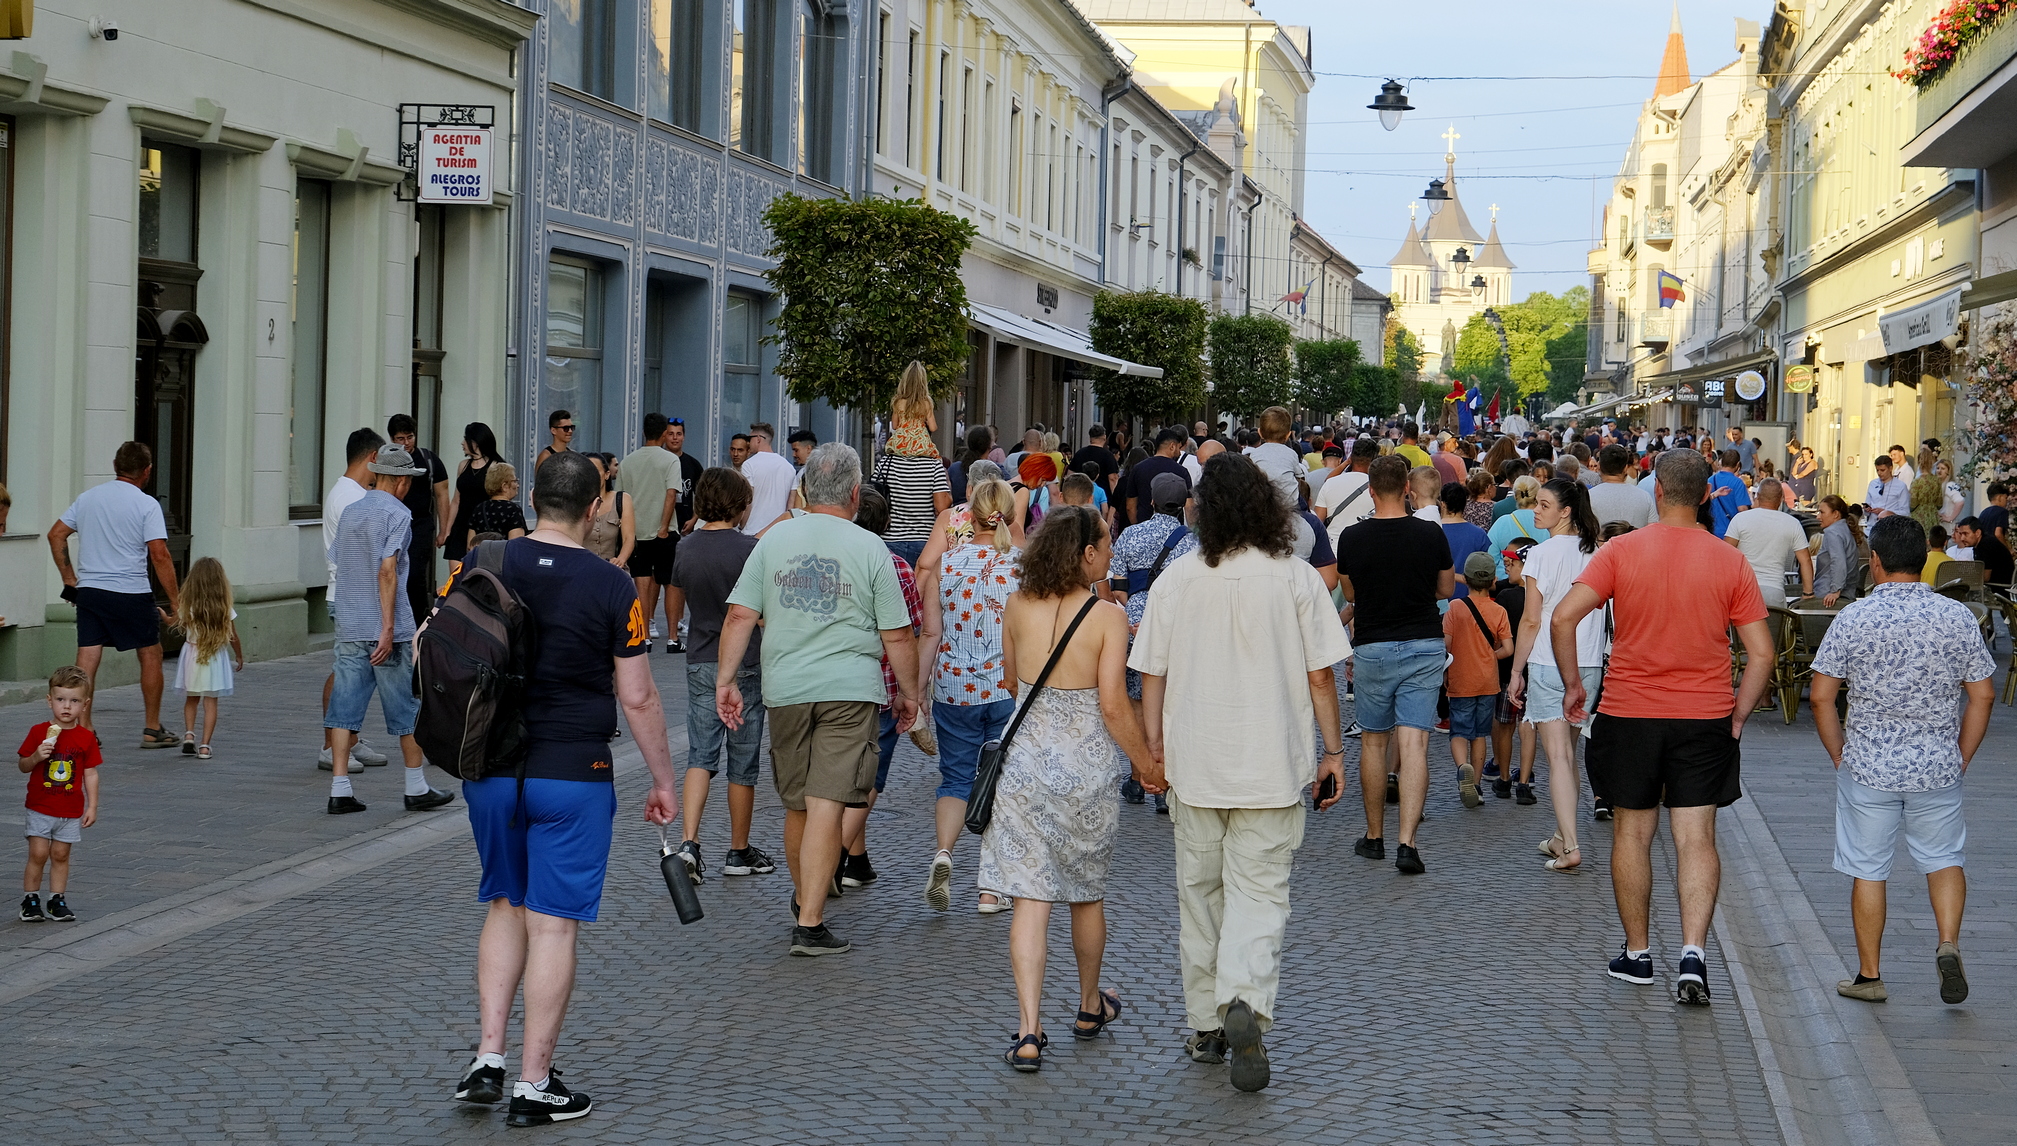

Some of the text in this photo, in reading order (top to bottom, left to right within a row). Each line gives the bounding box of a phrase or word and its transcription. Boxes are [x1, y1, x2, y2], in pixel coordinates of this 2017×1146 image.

[433, 134, 481, 145] AGENTIA
[449, 146, 465, 156] DE
[435, 157, 477, 168] TURISM
[430, 173, 481, 185] ALEGROS
[442, 186, 481, 197] TOURS
[268, 318, 275, 341] 2
[774, 570, 852, 596] Golden Team
[542, 1095, 565, 1104] REPLAY
